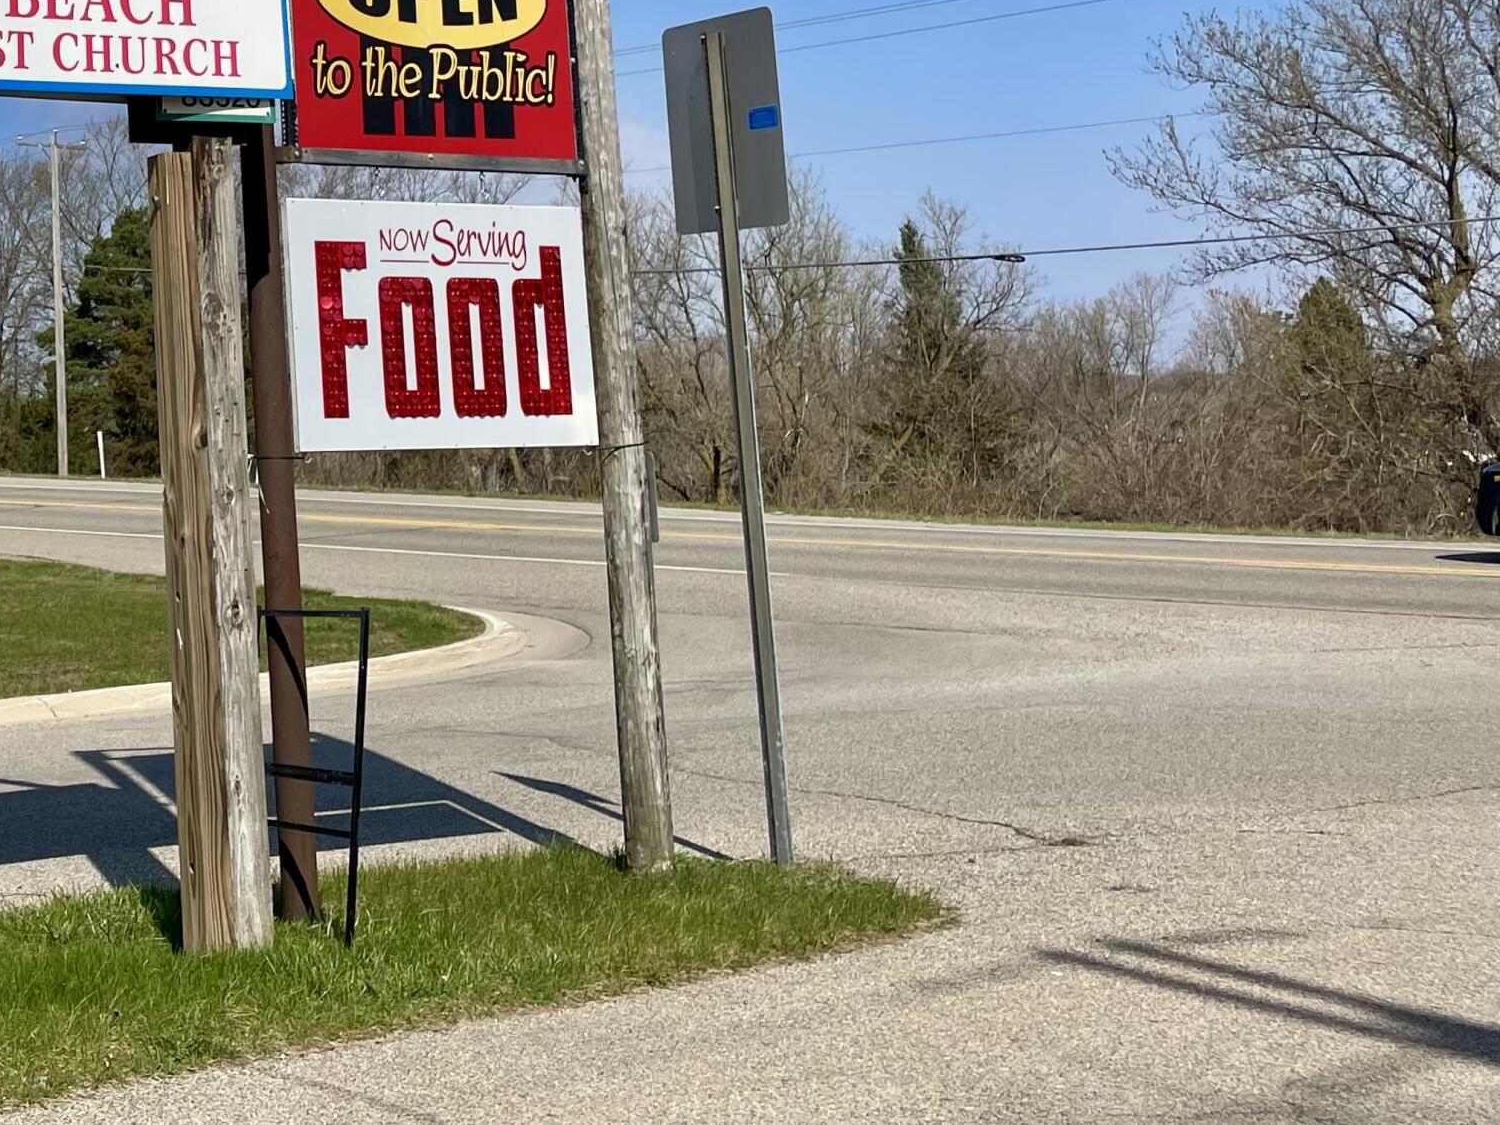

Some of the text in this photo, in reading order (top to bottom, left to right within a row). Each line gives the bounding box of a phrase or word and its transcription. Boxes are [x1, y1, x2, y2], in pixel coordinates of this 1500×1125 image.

[52, 32, 241, 77] CHURCH
[312, 43, 555, 104] to the Public!
[379, 219, 527, 271] NOW Serving
[314, 240, 573, 419] Food
